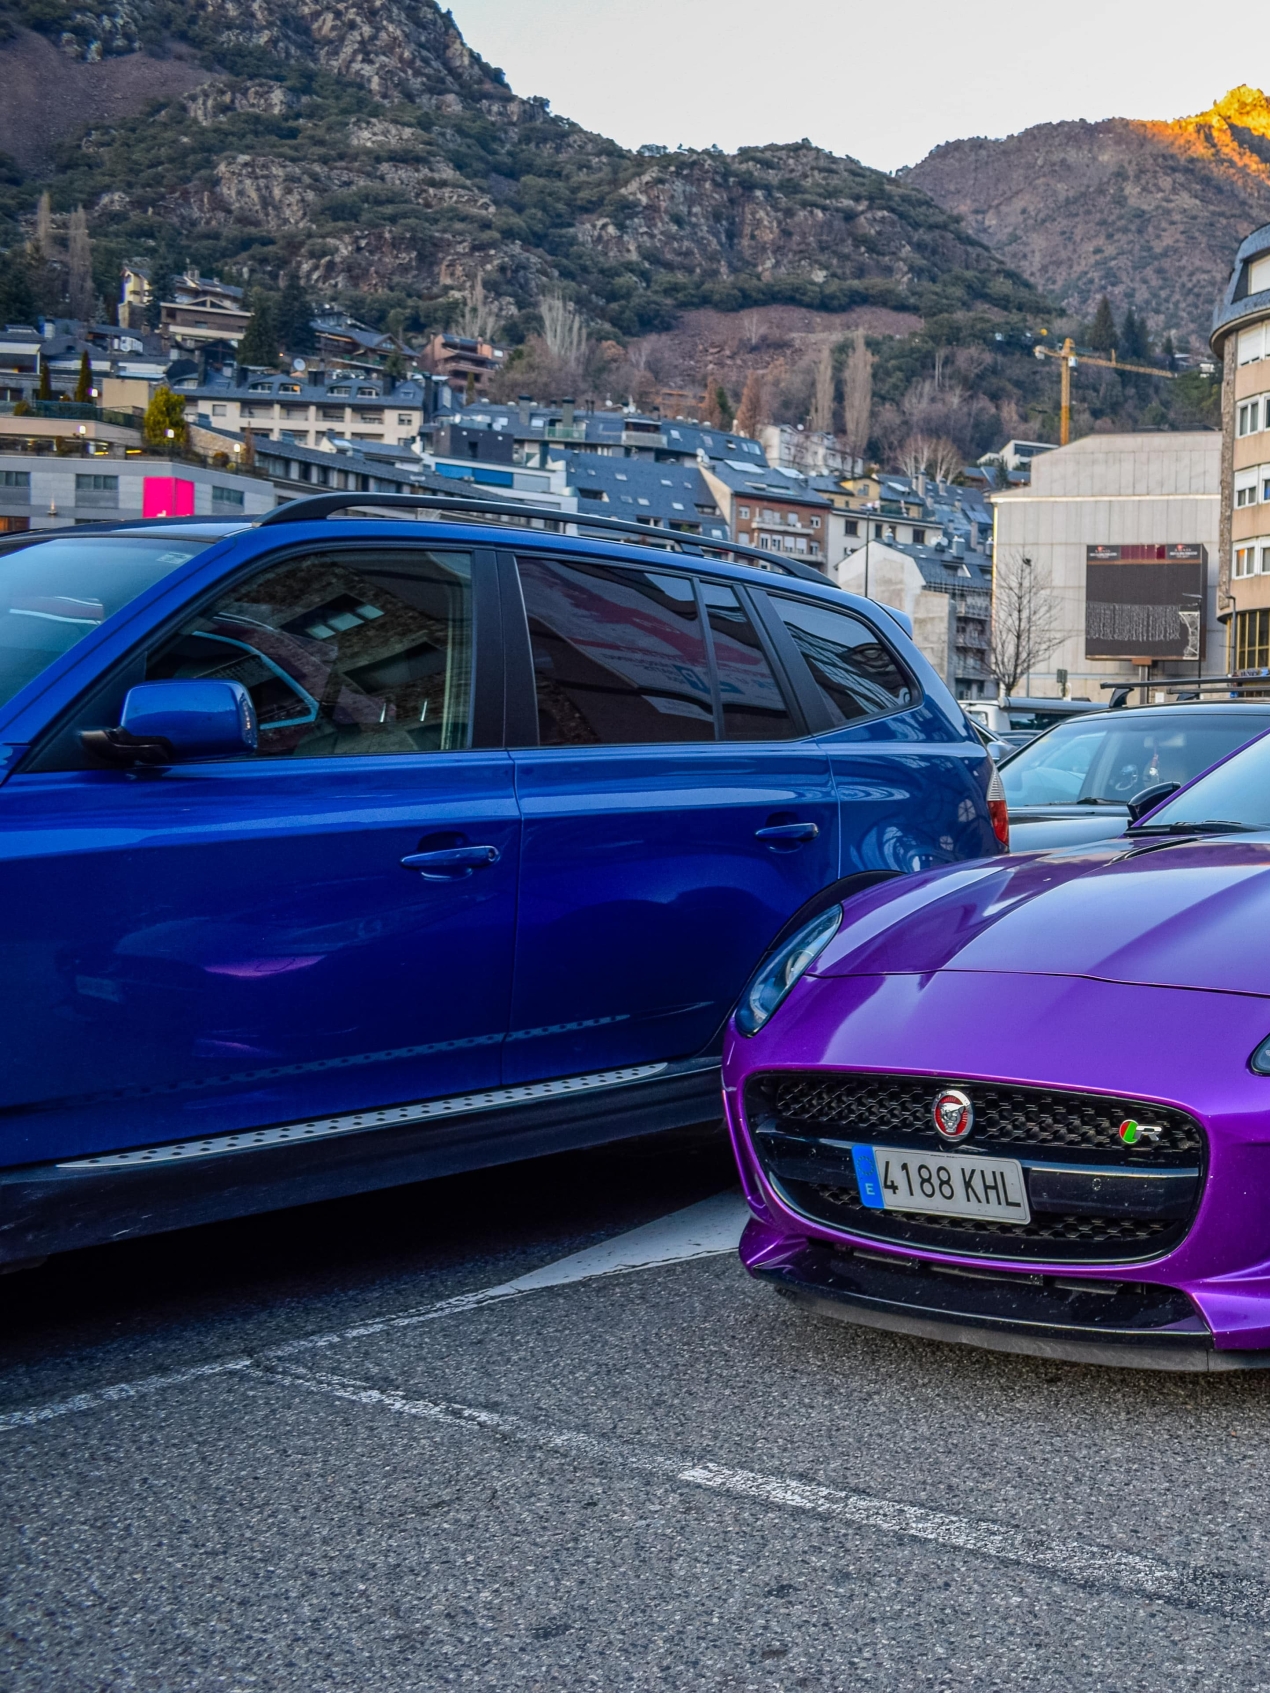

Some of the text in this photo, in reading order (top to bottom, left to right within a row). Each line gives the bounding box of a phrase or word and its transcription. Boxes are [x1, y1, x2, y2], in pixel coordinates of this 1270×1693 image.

[1134, 1125, 1162, 1141] R
[865, 1182, 876, 1196] E
[883, 1160, 1022, 1208] 4188 KHL
